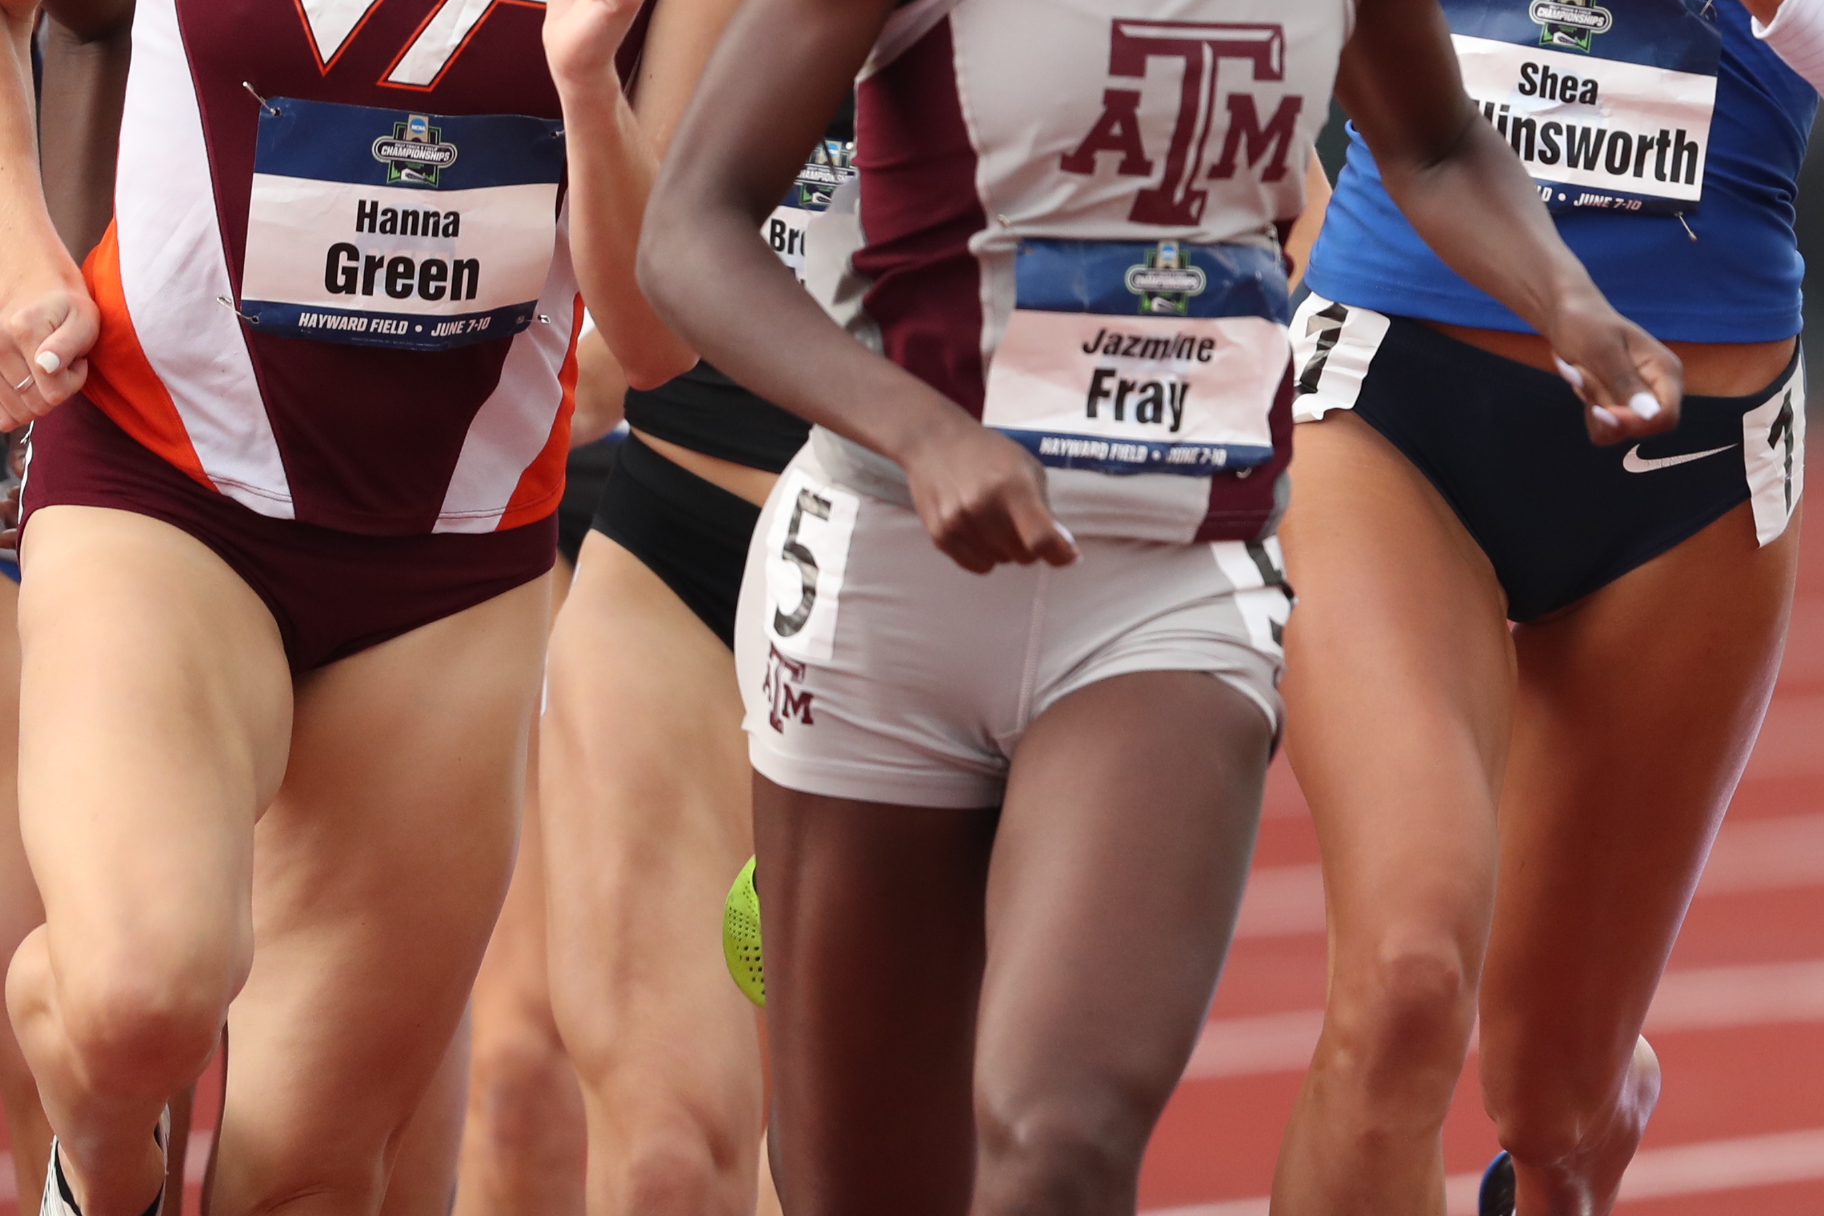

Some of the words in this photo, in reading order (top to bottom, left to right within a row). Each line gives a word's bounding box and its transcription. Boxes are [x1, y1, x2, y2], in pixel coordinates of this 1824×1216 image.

[1518, 62, 1599, 105] Shea
[381, 145, 450, 162] CHAMPIONSHIPS
[355, 199, 460, 238] Hanna
[1573, 192, 1613, 208] JUNE
[1613, 197, 1643, 211] 7-10
[324, 242, 480, 301] Green
[298, 312, 368, 332] HAYWARD
[369, 318, 409, 335] FIELD
[430, 320, 464, 337] JUNE
[465, 316, 491, 334] 7-10
[1082, 327, 1216, 363] Jazmine
[1086, 367, 1191, 432] Fray
[773, 487, 832, 638] 5
